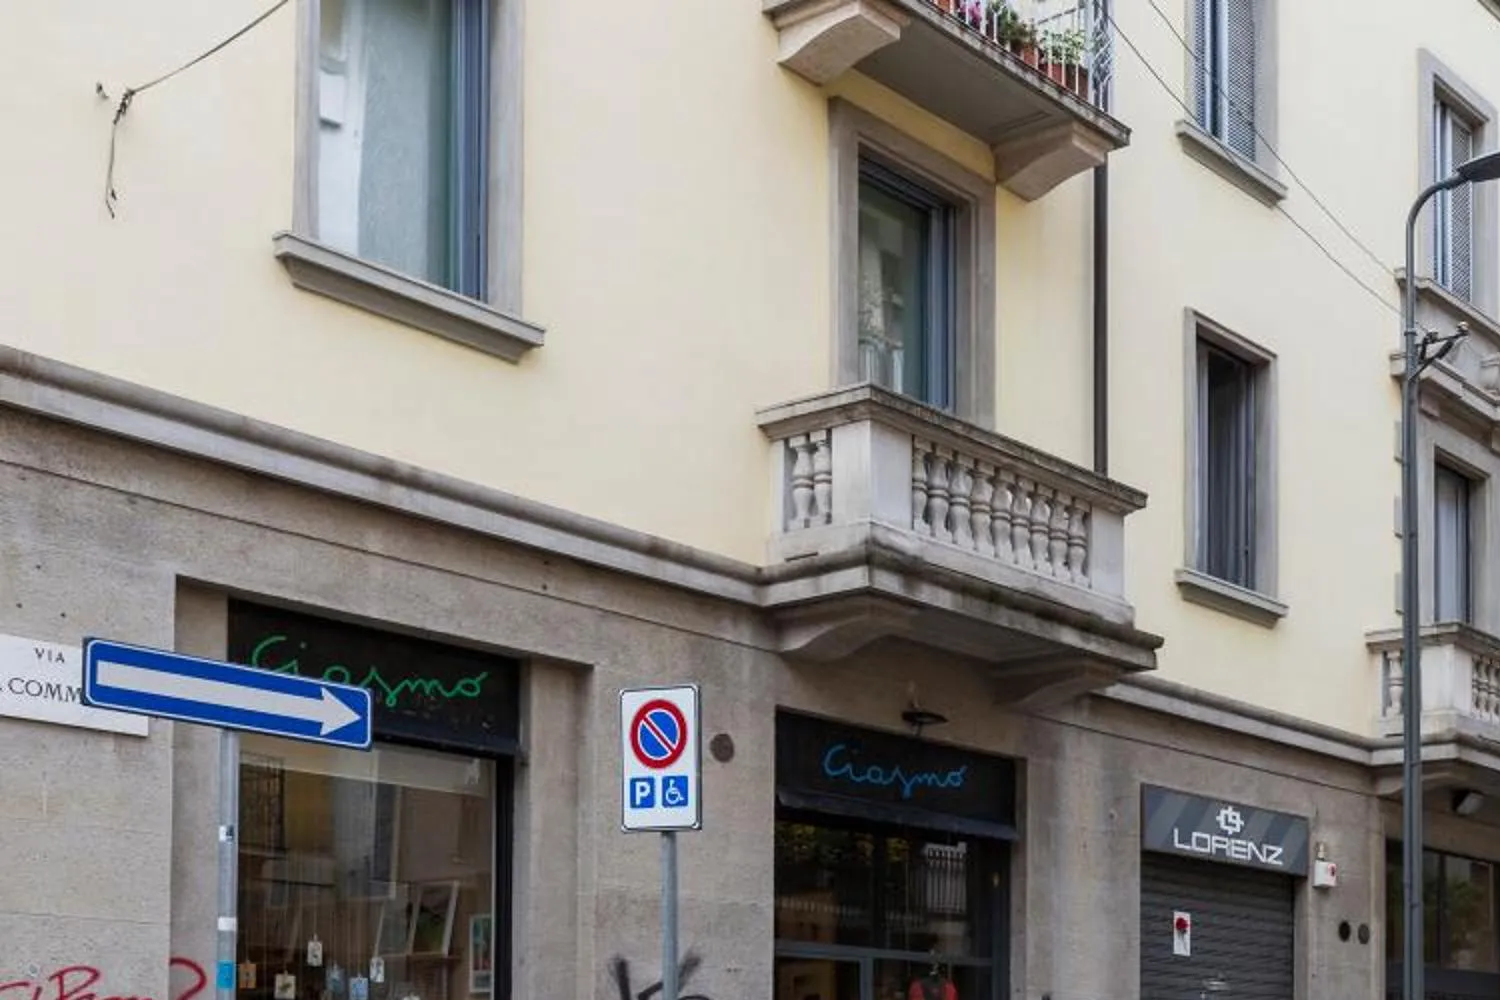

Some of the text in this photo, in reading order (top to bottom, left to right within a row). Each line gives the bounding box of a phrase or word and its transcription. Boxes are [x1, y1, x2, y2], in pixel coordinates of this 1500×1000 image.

[34, 647, 65, 664] VIA
[8, 677, 84, 703] COMM
[635, 781, 650, 805] P
[1173, 828, 1284, 866] LORENZ
